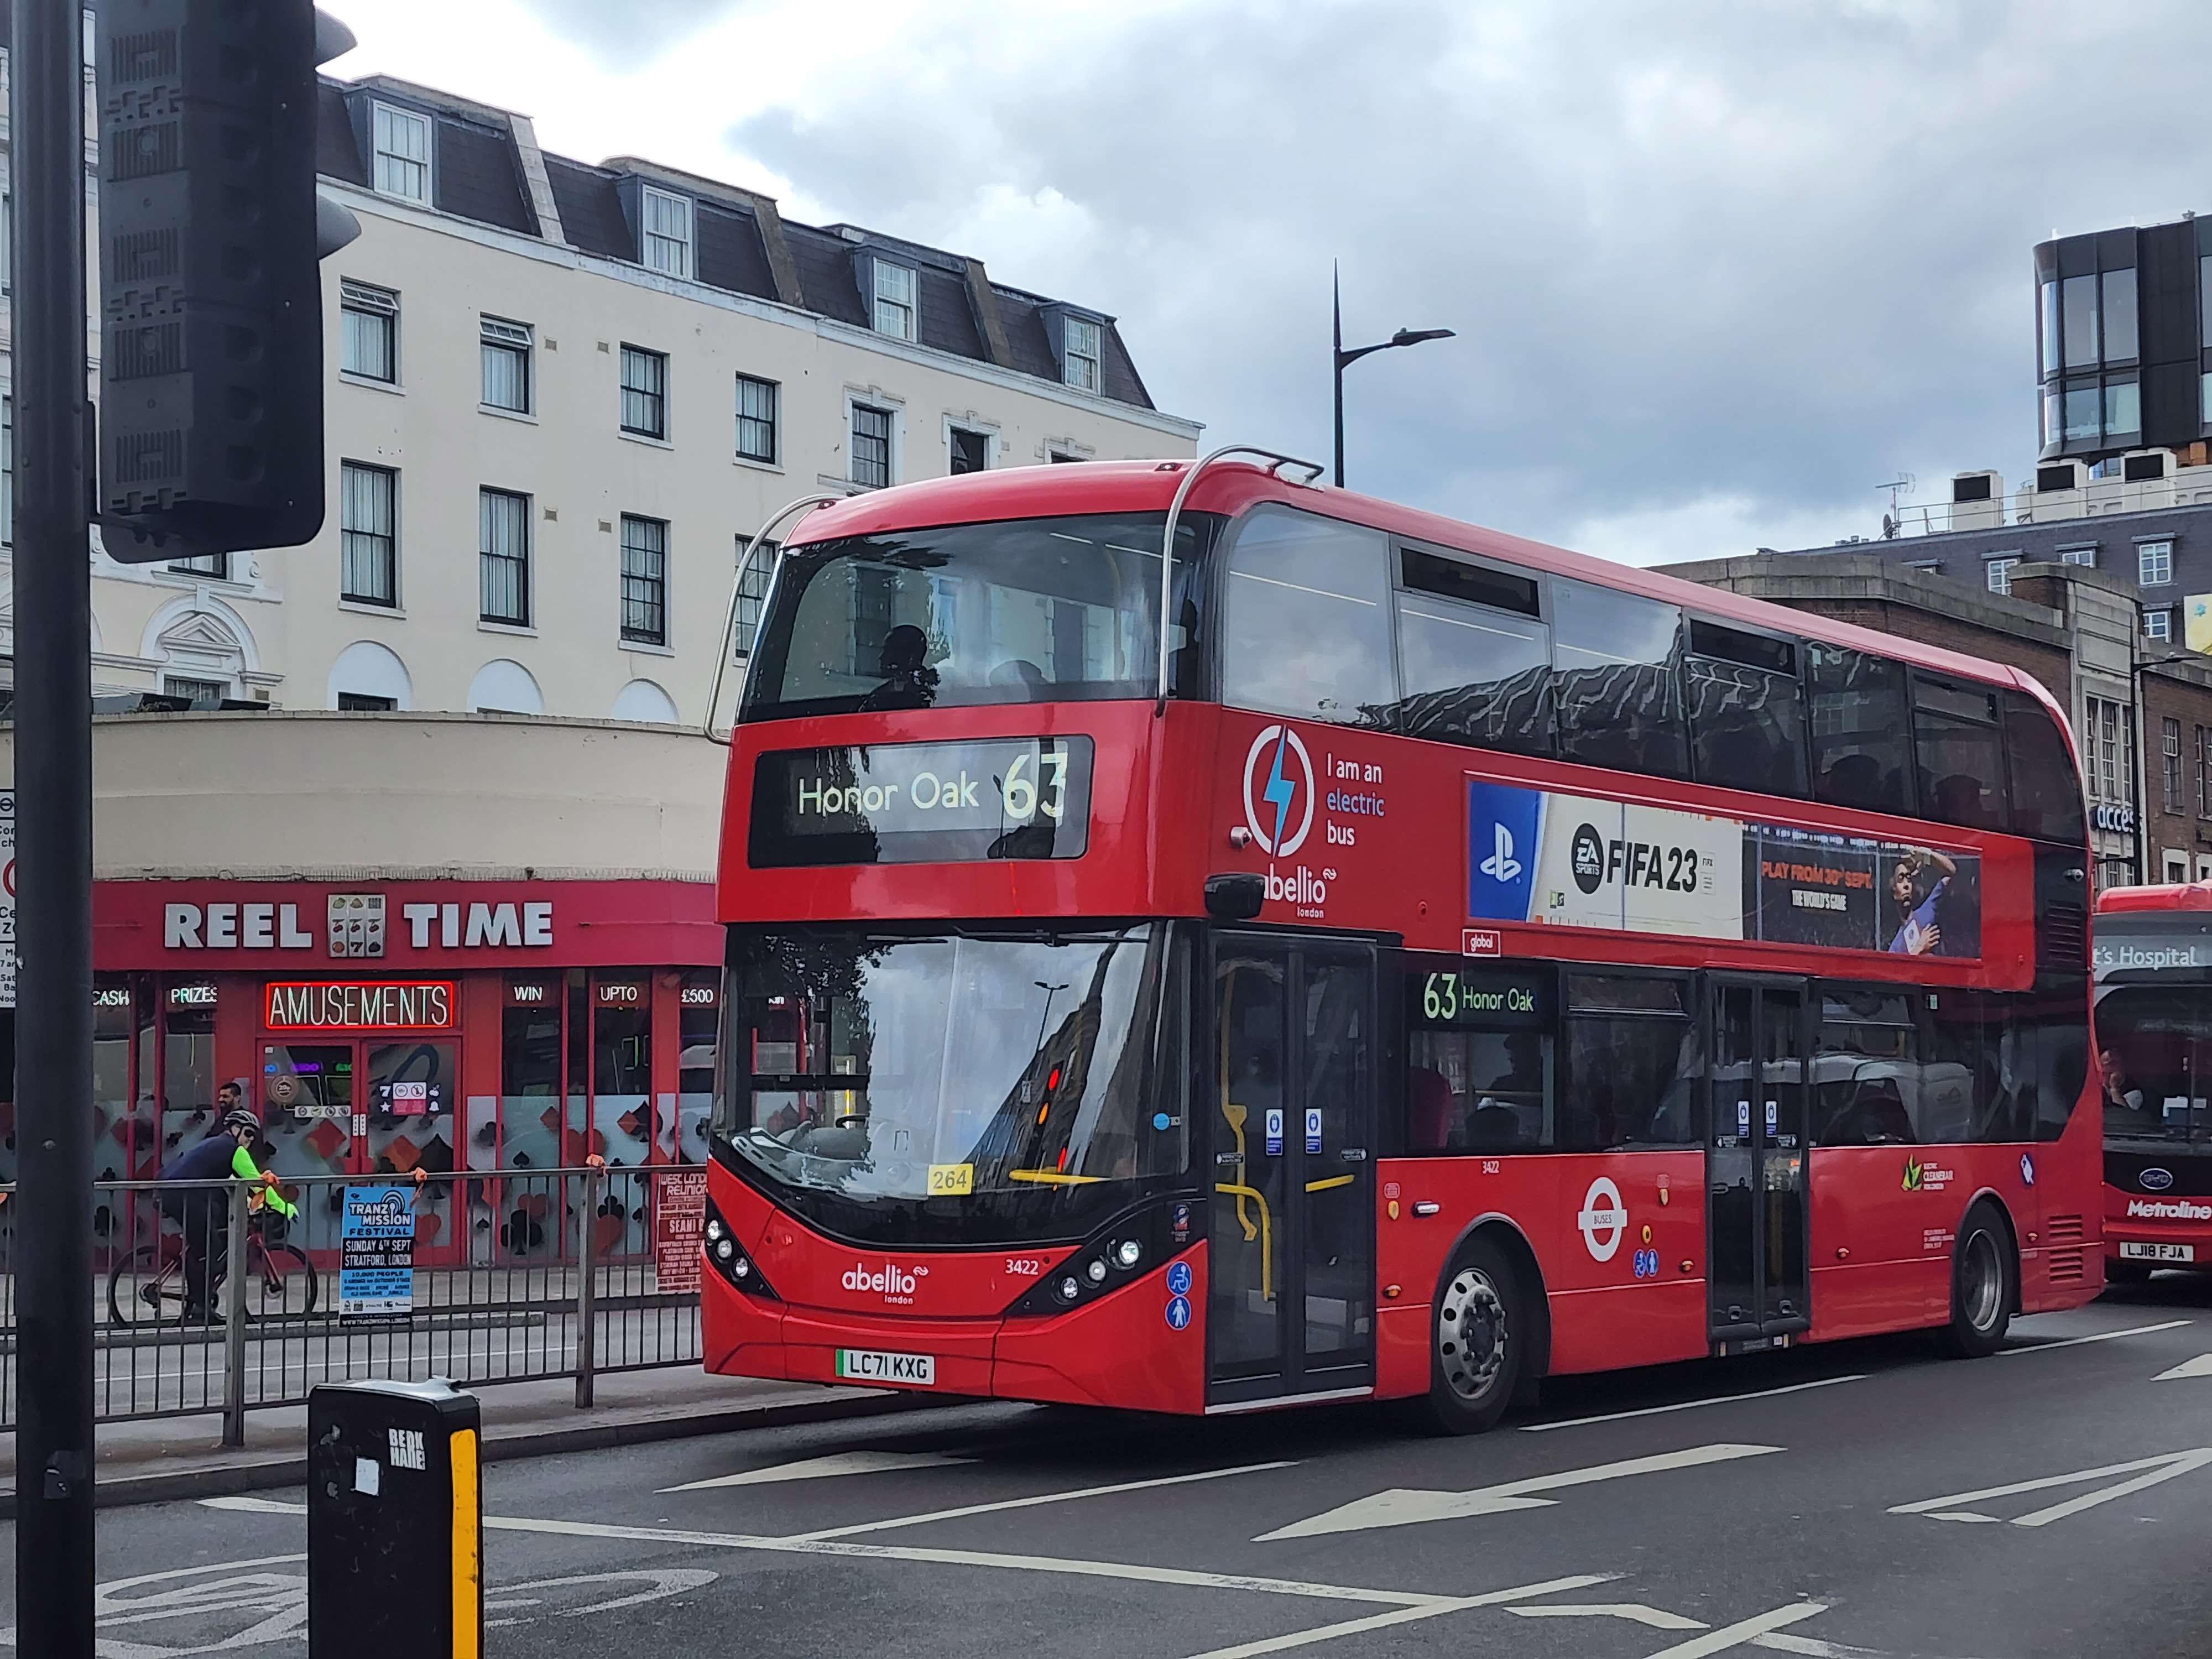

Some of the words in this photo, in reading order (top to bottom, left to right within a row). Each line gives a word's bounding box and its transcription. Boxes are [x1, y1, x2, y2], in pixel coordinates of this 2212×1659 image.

[1327, 753, 1332, 777] I
[1336, 760, 1359, 781] am
[1364, 763, 1382, 784] an
[798, 776, 898, 817] Honor
[911, 770, 979, 810] Oak
[1003, 752, 1068, 818] 63
[1327, 787, 1385, 817] electric
[1327, 820, 1355, 846] bus
[1576, 838, 1600, 864] EA
[1575, 863, 1600, 877] SPORTS
[1761, 861, 1790, 879] PLAY
[1791, 864, 1823, 883] FROM
[1264, 863, 1326, 905] bellio
[1297, 906, 1324, 919] london
[164, 903, 312, 948] REEL
[403, 901, 553, 948] TIME
[1470, 933, 1493, 952] global
[2119, 945, 2197, 971] Hospital
[170, 987, 217, 1004] PRIZES
[514, 986, 542, 1001] WIN
[600, 986, 638, 1001] UPTO
[681, 988, 714, 1003] £500
[1424, 972, 1458, 1020] 63
[1463, 985, 1504, 1010] Honor
[1508, 988, 1534, 1012] Oak
[269, 985, 448, 1026] AMUSEMENTS
[1482, 1160, 1500, 1174] 3422
[661, 1173, 683, 1186] WEST
[933, 1169, 967, 1190] 264
[349, 1203, 389, 1214] TRANZ
[2127, 1199, 2212, 1220] Metroline
[362, 1214, 410, 1225] MISSION
[1594, 1214, 1612, 1225] BUSES
[349, 1228, 410, 1236] FESTIVAL
[345, 1240, 377, 1253] SUNDAY
[391, 1239, 411, 1252] SEPT
[2127, 1244, 2156, 1258] LJ18
[2159, 1245, 2185, 1259] FJA
[345, 1254, 387, 1267] STRATFORD,
[388, 1254, 412, 1266] LONDON
[1005, 1259, 1039, 1276] 3422
[841, 1262, 916, 1294] abellio
[884, 1294, 914, 1305] london
[849, 1352, 888, 1377] LC71
[893, 1356, 928, 1379] KXG
